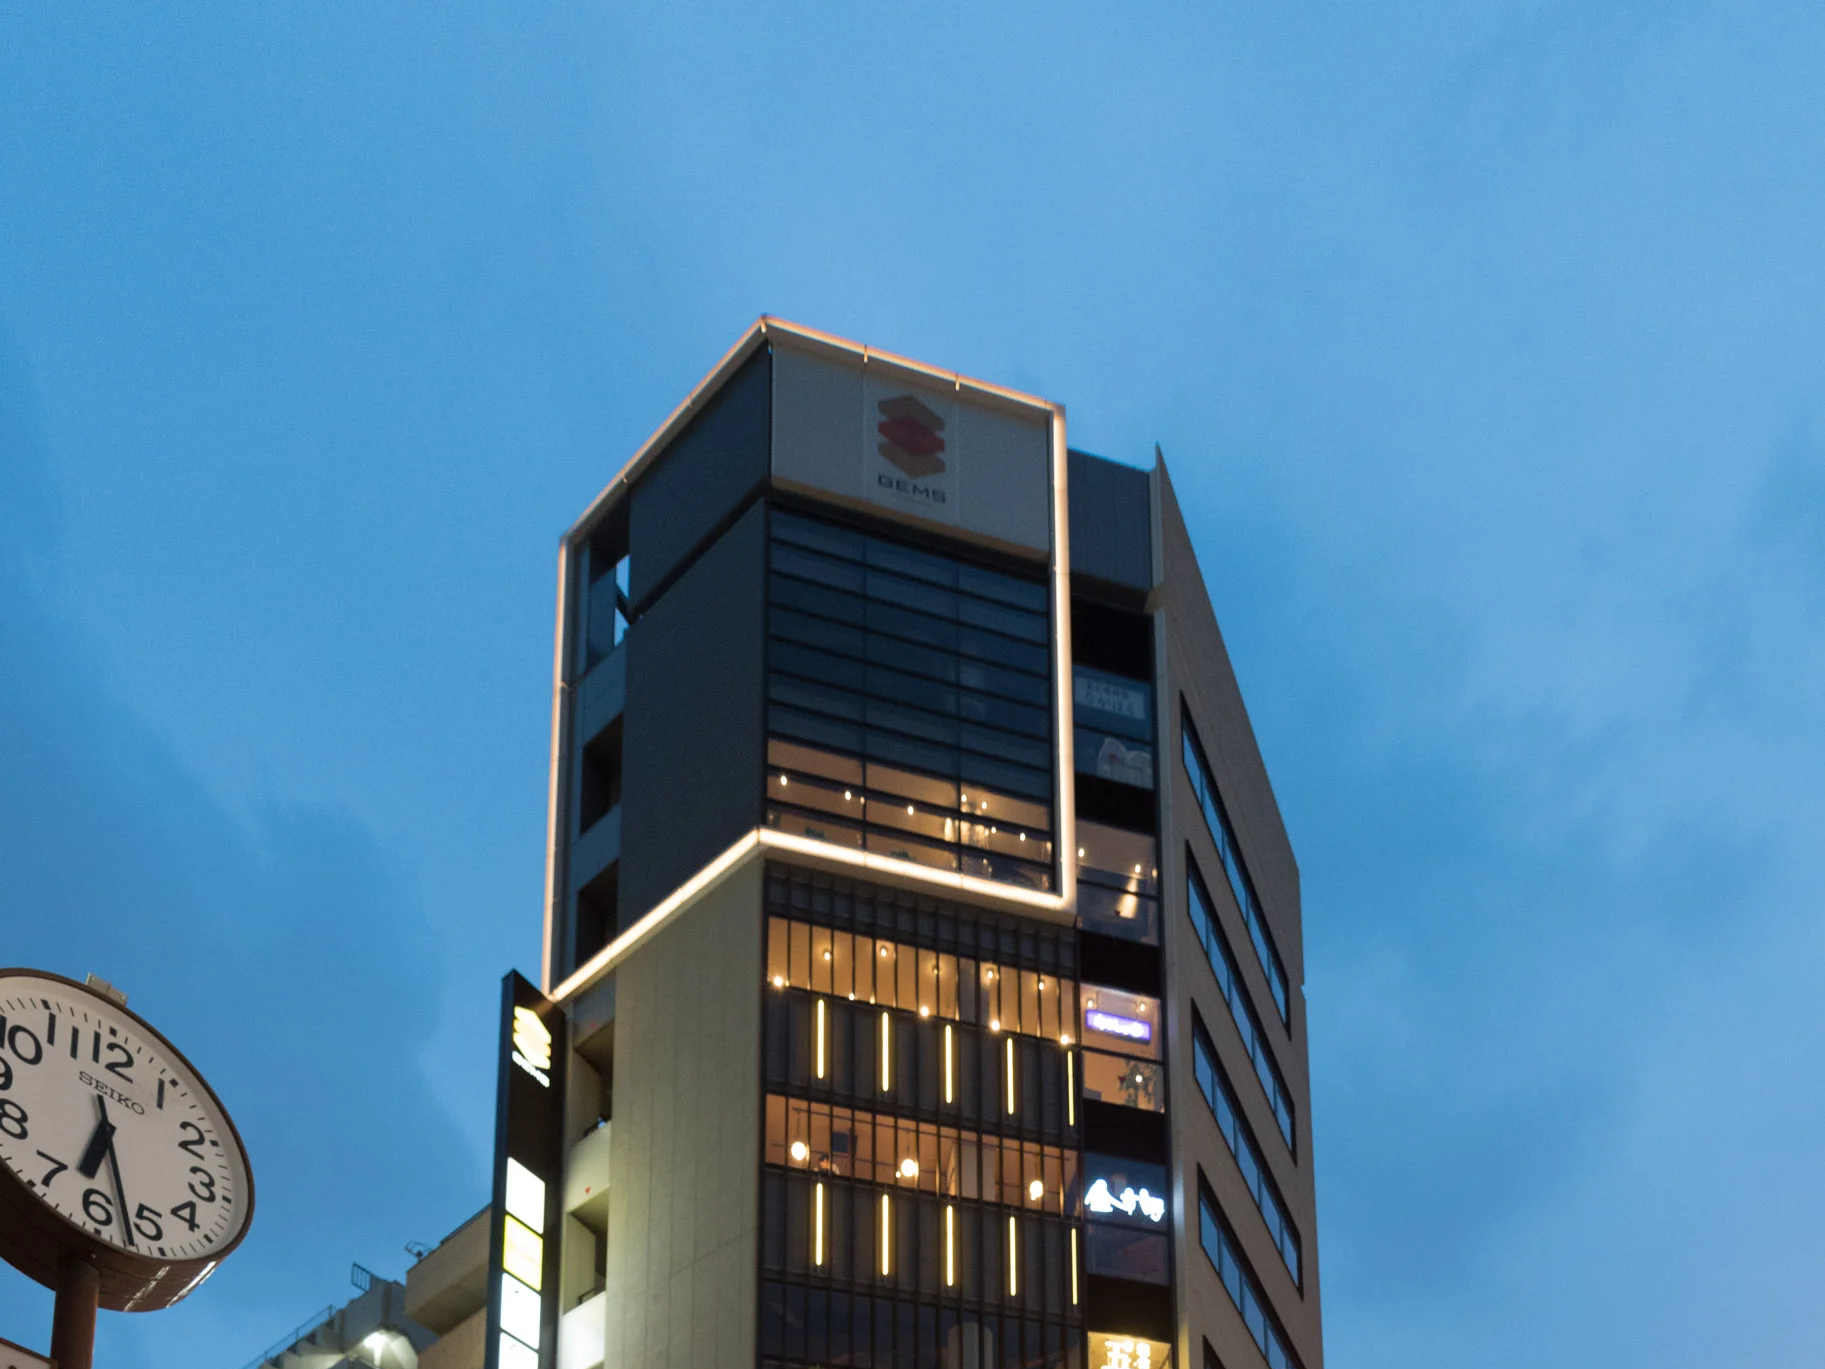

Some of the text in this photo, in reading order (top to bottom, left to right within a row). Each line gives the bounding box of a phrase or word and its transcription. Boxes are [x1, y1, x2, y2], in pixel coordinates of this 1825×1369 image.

[878, 474, 946, 503] GEMS
[46, 1012, 80, 1060] 11
[92, 1030, 134, 1084] 12
[79, 1070, 145, 1115] SEIKO
[156, 1077, 165, 1110] 1
[0, 1098, 28, 1140] 8
[178, 1120, 205, 1160] 2
[36, 1149, 68, 1188] 7
[187, 1166, 216, 1203] 3
[82, 1188, 114, 1226] 6
[133, 1202, 163, 1241] 5
[170, 1200, 200, 1232] 4
